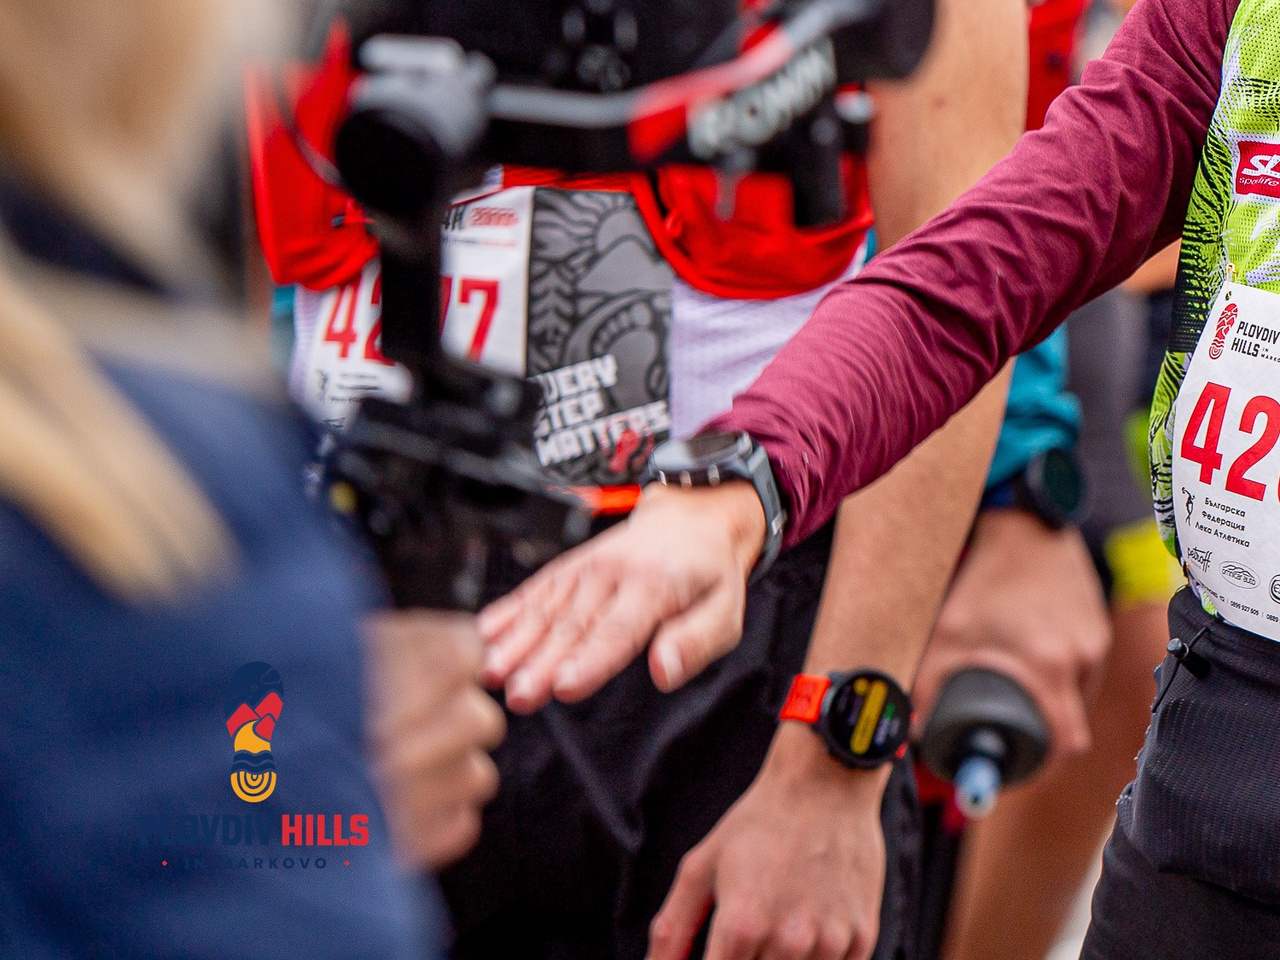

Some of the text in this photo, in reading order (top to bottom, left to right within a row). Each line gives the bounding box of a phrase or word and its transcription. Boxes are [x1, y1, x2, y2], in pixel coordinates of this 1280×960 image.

[323, 270, 499, 366] 427
[1236, 321, 1280, 345] PLOVDIV
[1231, 339, 1260, 358] HILLS
[527, 354, 618, 404] VERY
[1205, 497, 1246, 517] Българска
[1195, 522, 1250, 548] Лека Атлетика
